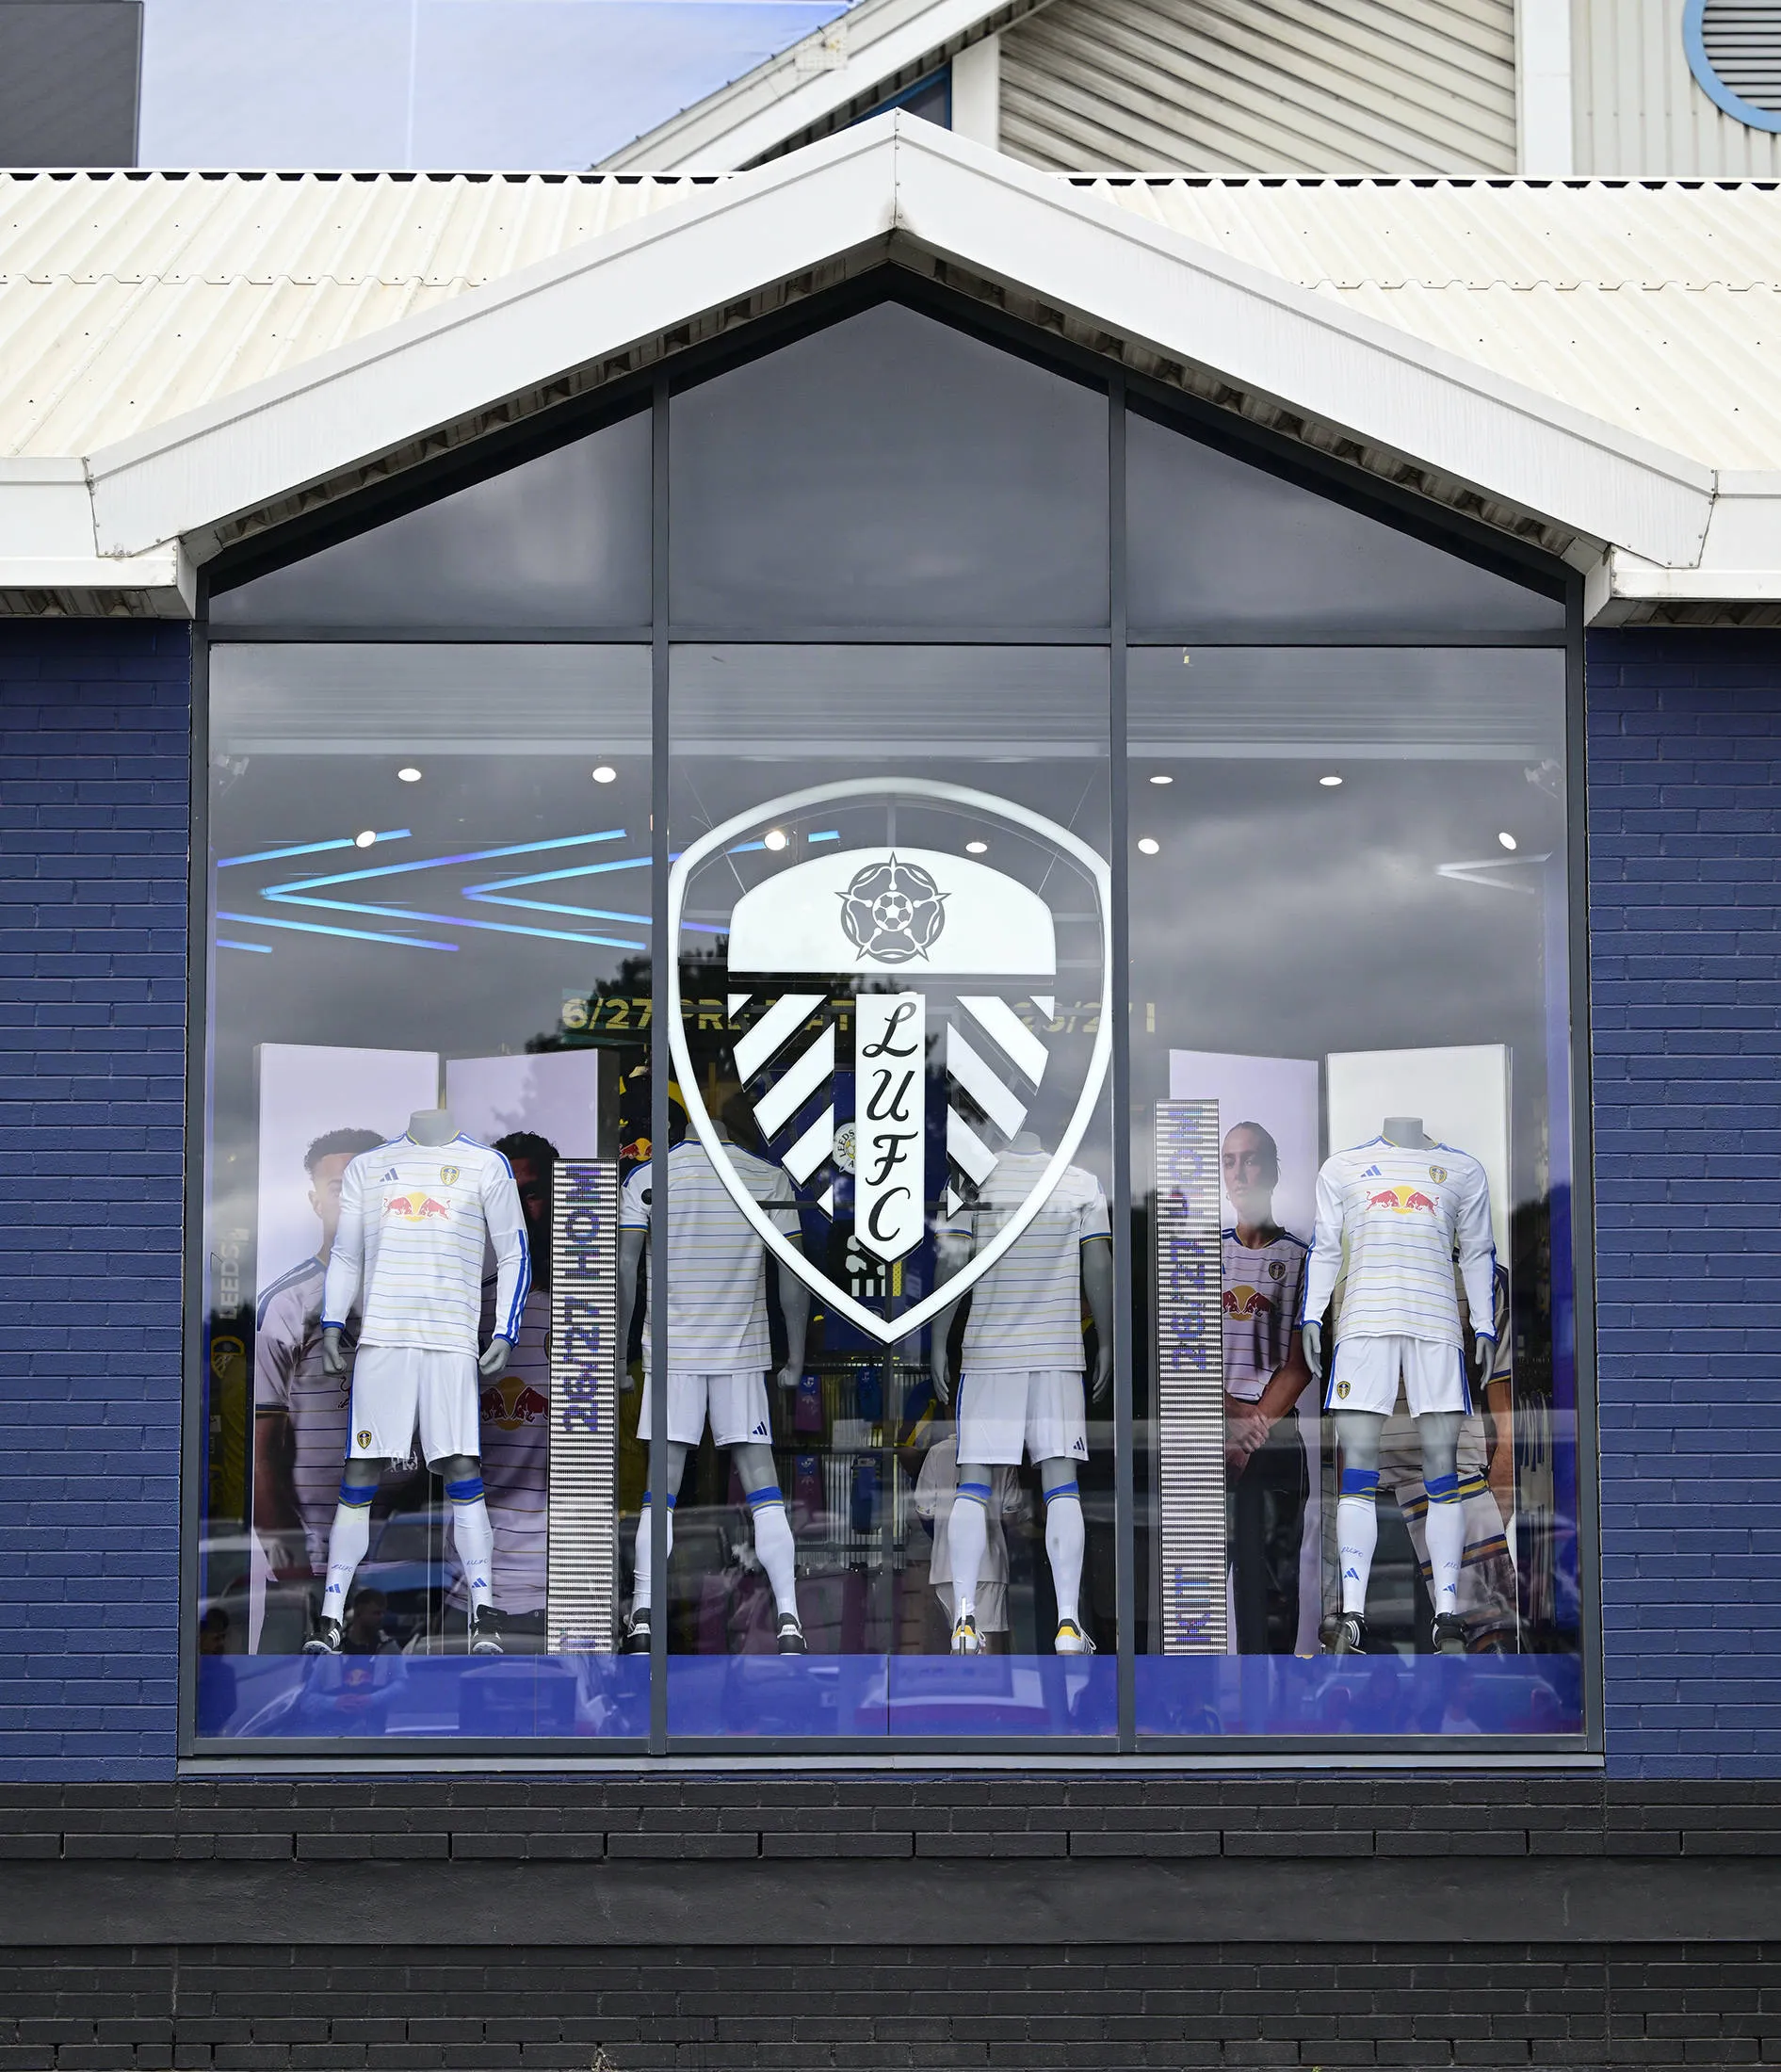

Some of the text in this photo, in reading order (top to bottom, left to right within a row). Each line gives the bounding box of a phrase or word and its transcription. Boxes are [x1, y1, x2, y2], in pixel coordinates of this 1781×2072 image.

[836, 1128, 855, 1158] LEEDS
[219, 1241, 240, 1319] LEEDS
[562, 1164, 602, 1432] 26/27 HOM
[1175, 1568, 1212, 1643] KIT
